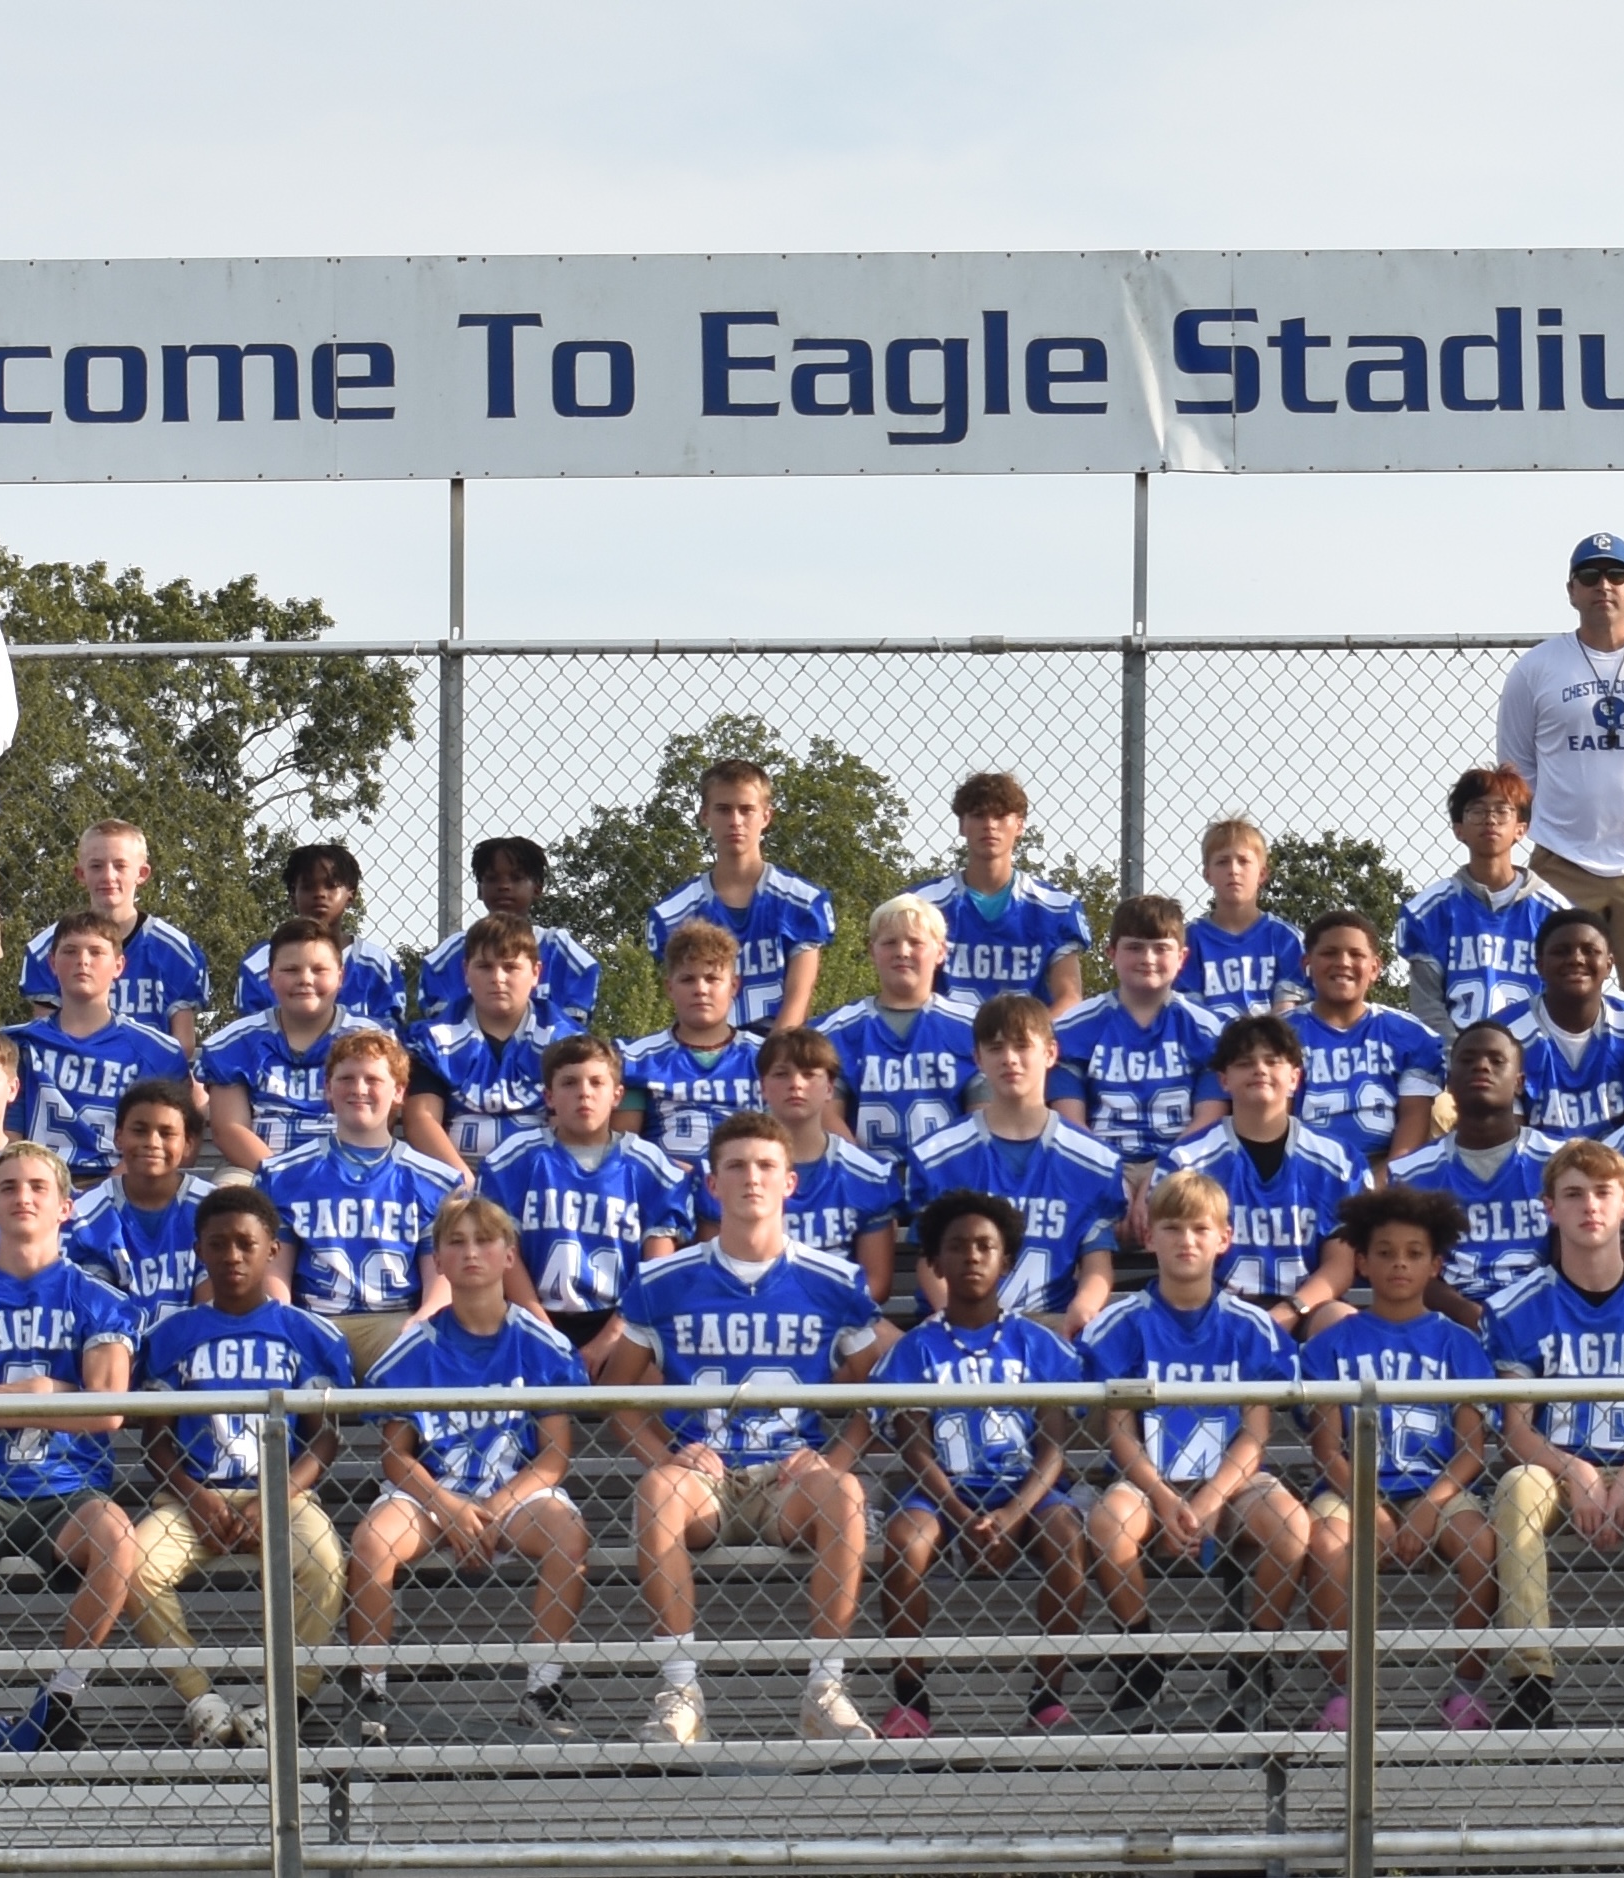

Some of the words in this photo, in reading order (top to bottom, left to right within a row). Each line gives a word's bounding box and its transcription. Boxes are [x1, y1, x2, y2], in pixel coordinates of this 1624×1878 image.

[458, 314, 634, 418] To
[700, 310, 1107, 444] Eagle
[1562, 679, 1611, 702] CHESTER
[290, 1198, 420, 1243] EAGLES
[522, 1189, 643, 1243] EAGLES
[672, 1312, 823, 1357] EAGLES
